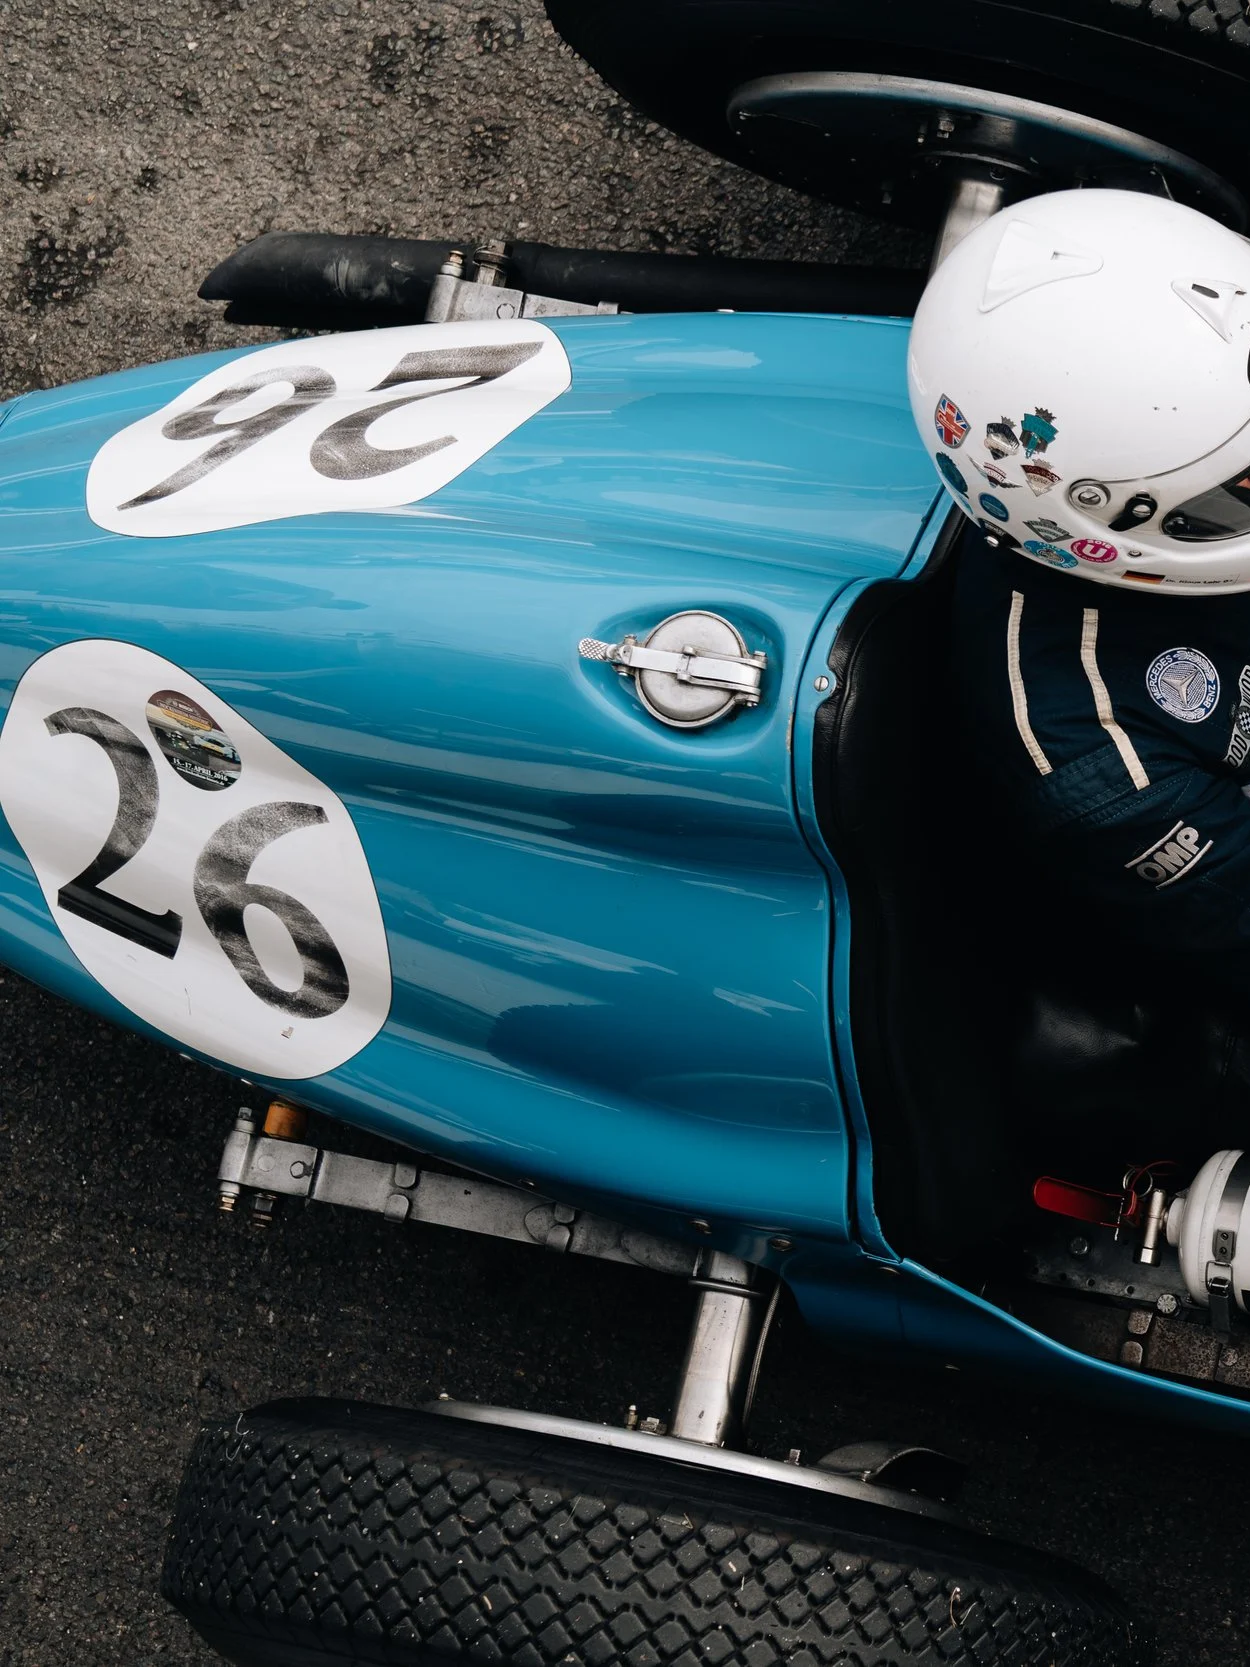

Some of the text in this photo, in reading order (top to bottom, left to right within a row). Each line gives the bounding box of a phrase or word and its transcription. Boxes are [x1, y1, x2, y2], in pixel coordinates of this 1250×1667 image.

[117, 341, 544, 511] 26
[1083, 543, 1108, 558] U
[1149, 654, 1217, 709] MERCEDES BENZ
[43, 706, 350, 1020] 26
[1136, 826, 1200, 881] OMP
